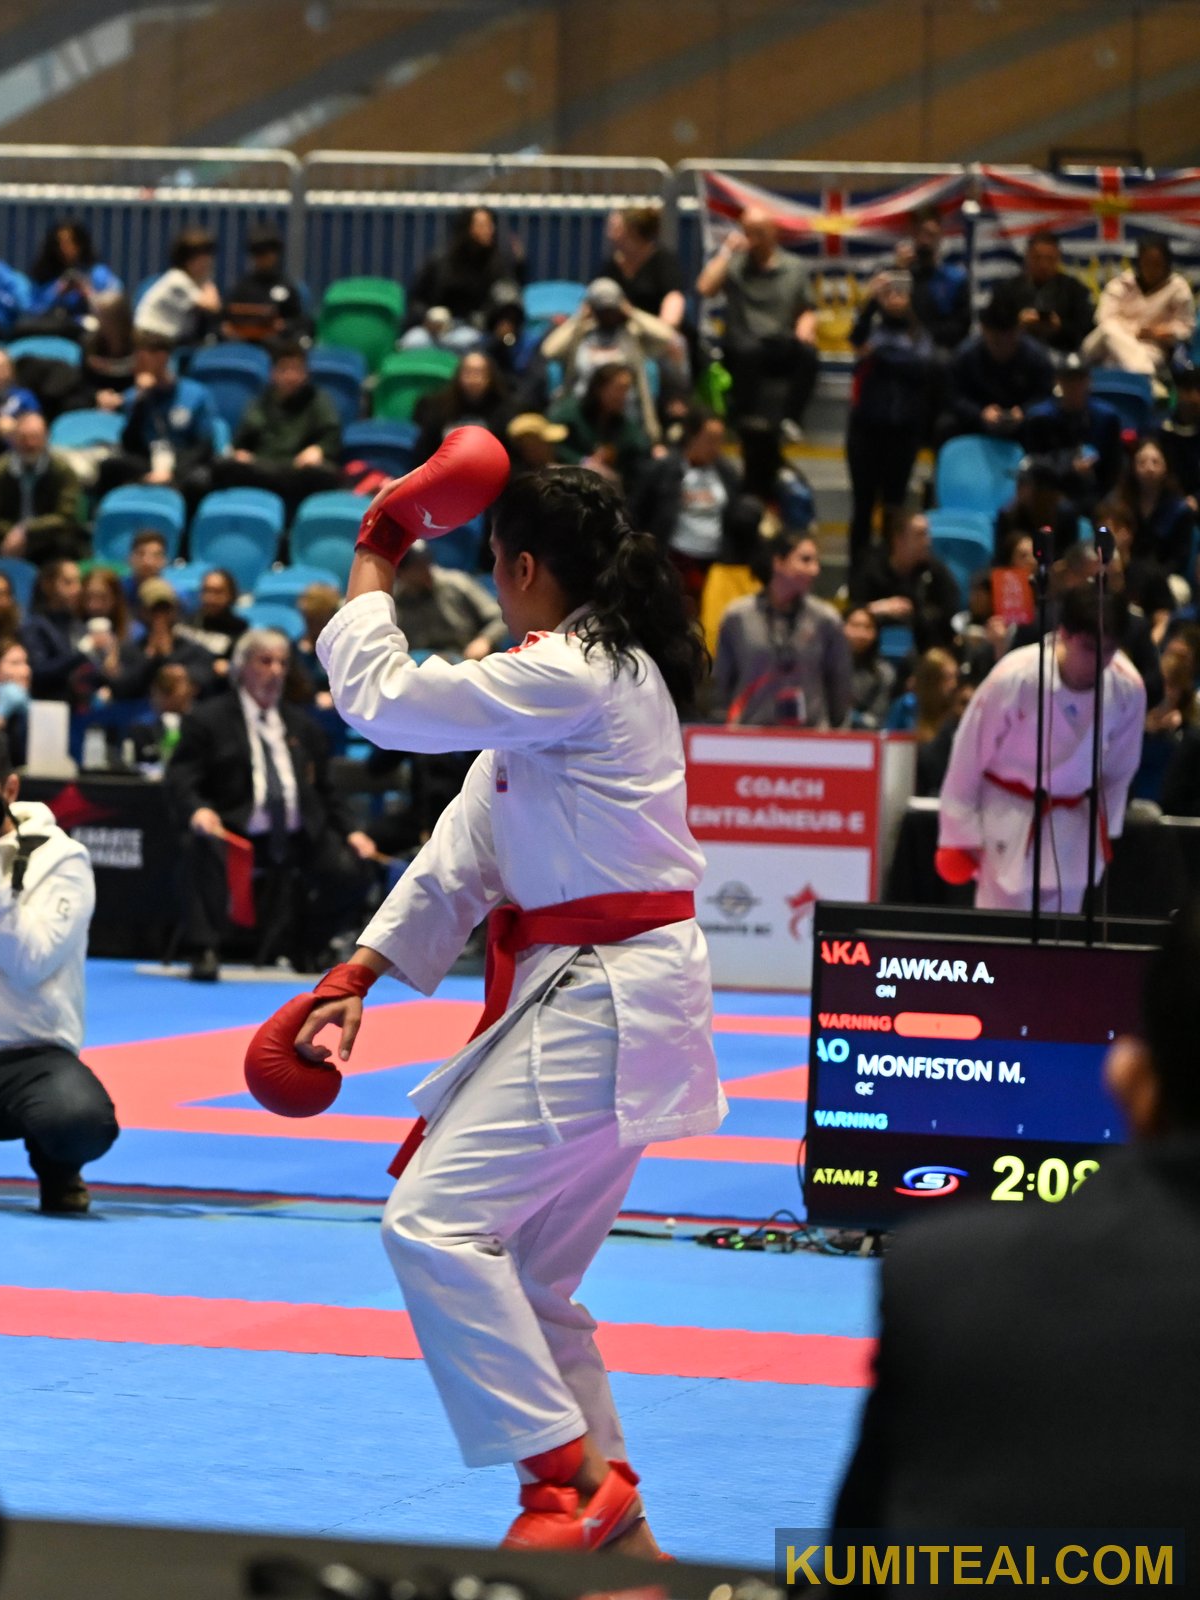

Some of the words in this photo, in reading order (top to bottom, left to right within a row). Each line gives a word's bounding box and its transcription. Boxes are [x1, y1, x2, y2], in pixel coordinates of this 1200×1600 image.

[735, 775, 825, 800] COACH
[876, 957, 968, 983] JAWKAR
[972, 961, 995, 984] A.
[856, 1054, 992, 1081] MONFISTON
[999, 1061, 1026, 1084] M.
[812, 1168, 865, 1187] ATAMI
[867, 1170, 878, 1188] 2
